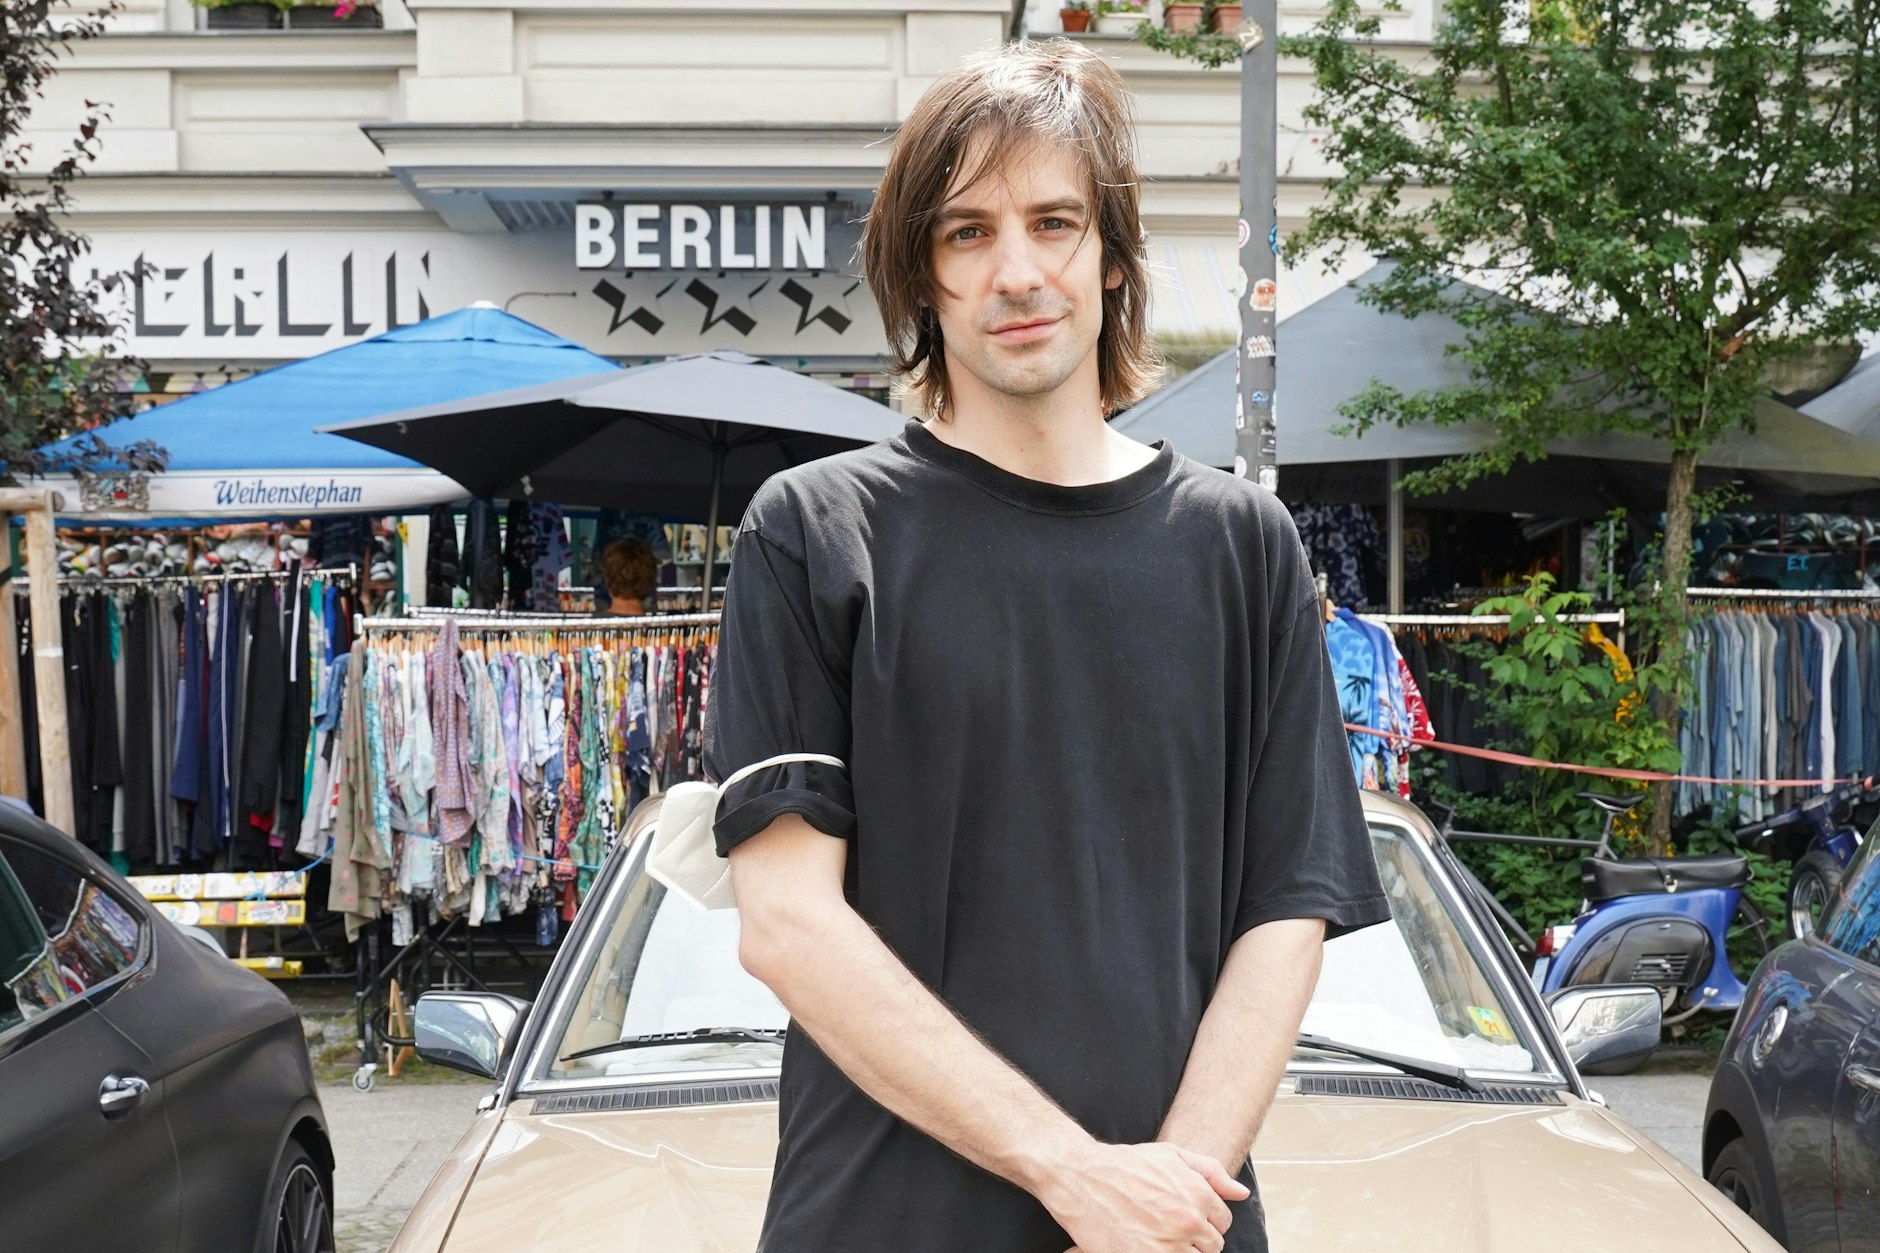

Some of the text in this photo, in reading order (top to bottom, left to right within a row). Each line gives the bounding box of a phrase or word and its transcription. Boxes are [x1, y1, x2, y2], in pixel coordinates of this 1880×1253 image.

[1238, 27, 1260, 49] 21
[575, 204, 825, 269] BERLIN
[213, 478, 363, 508] Weihenstephan
